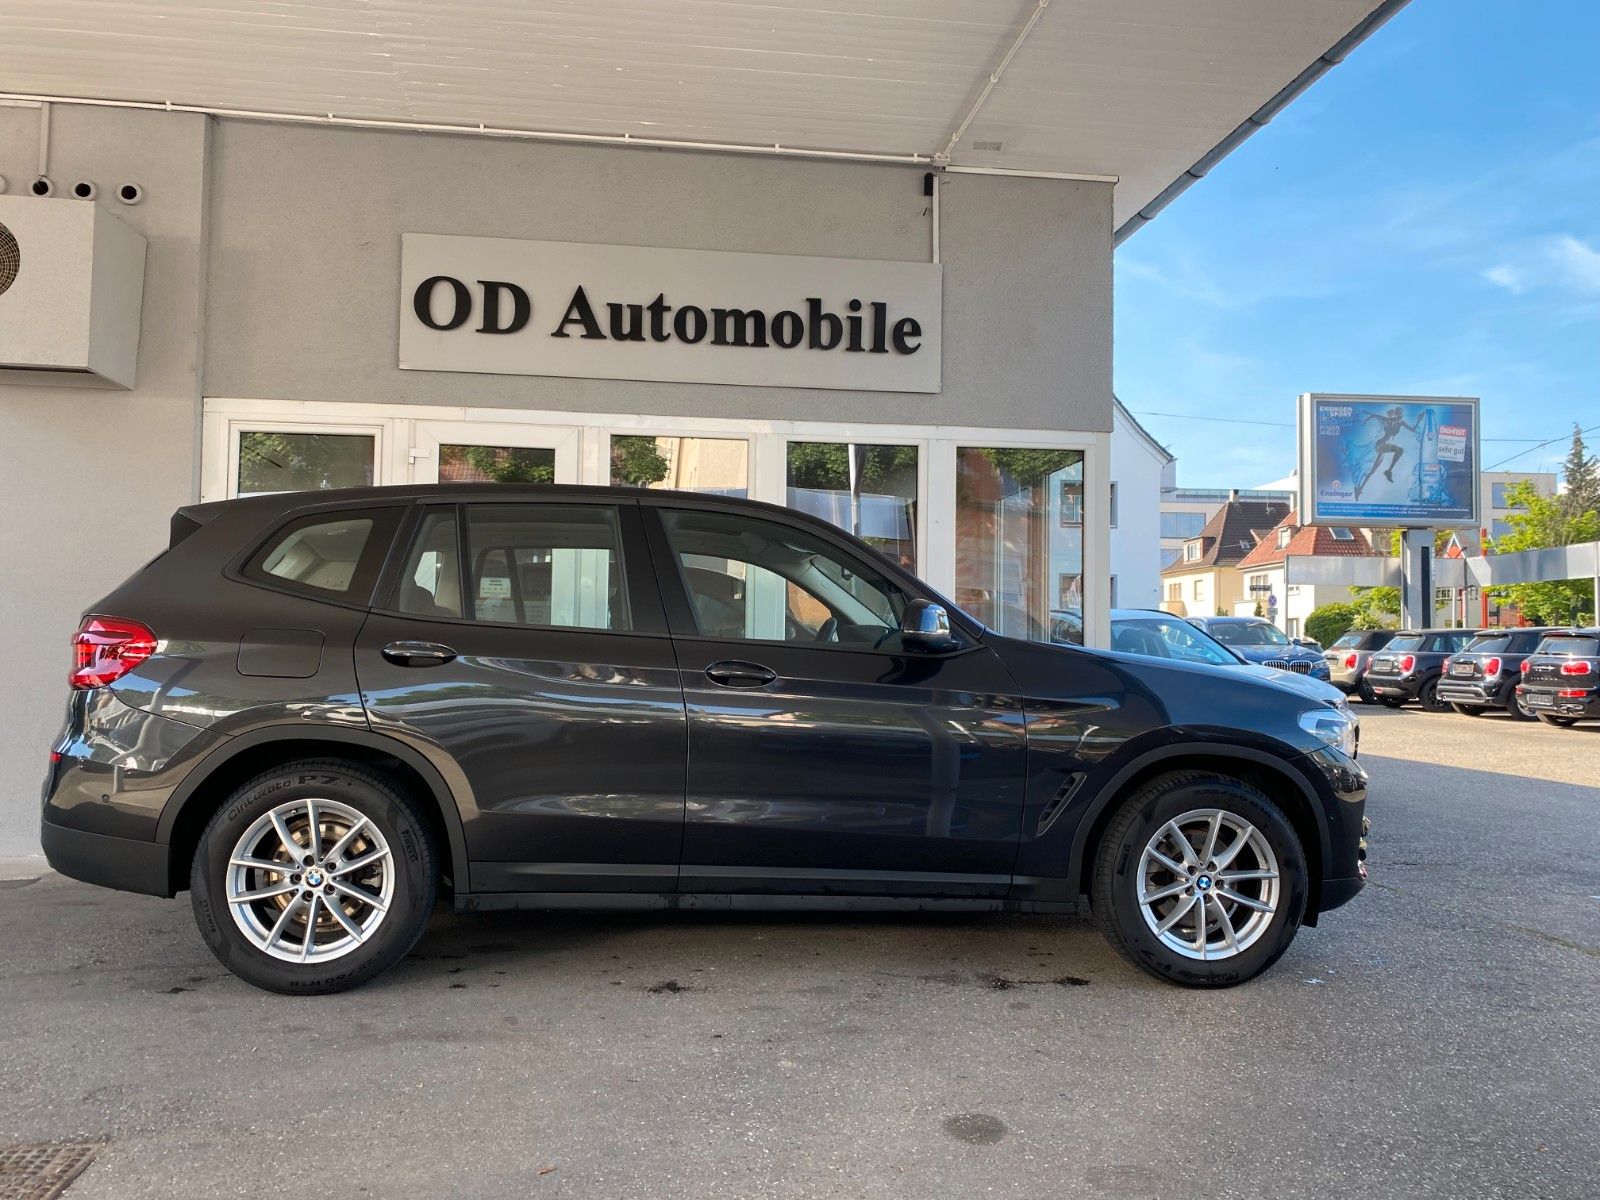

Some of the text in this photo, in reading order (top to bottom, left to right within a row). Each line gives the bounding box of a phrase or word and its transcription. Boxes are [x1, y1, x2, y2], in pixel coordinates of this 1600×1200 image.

[413, 275, 923, 355] OD Automobile
[1438, 445, 1465, 456] sehr gut
[1320, 489, 1353, 498] Ensinger
[227, 774, 340, 822] Cinturato P7
